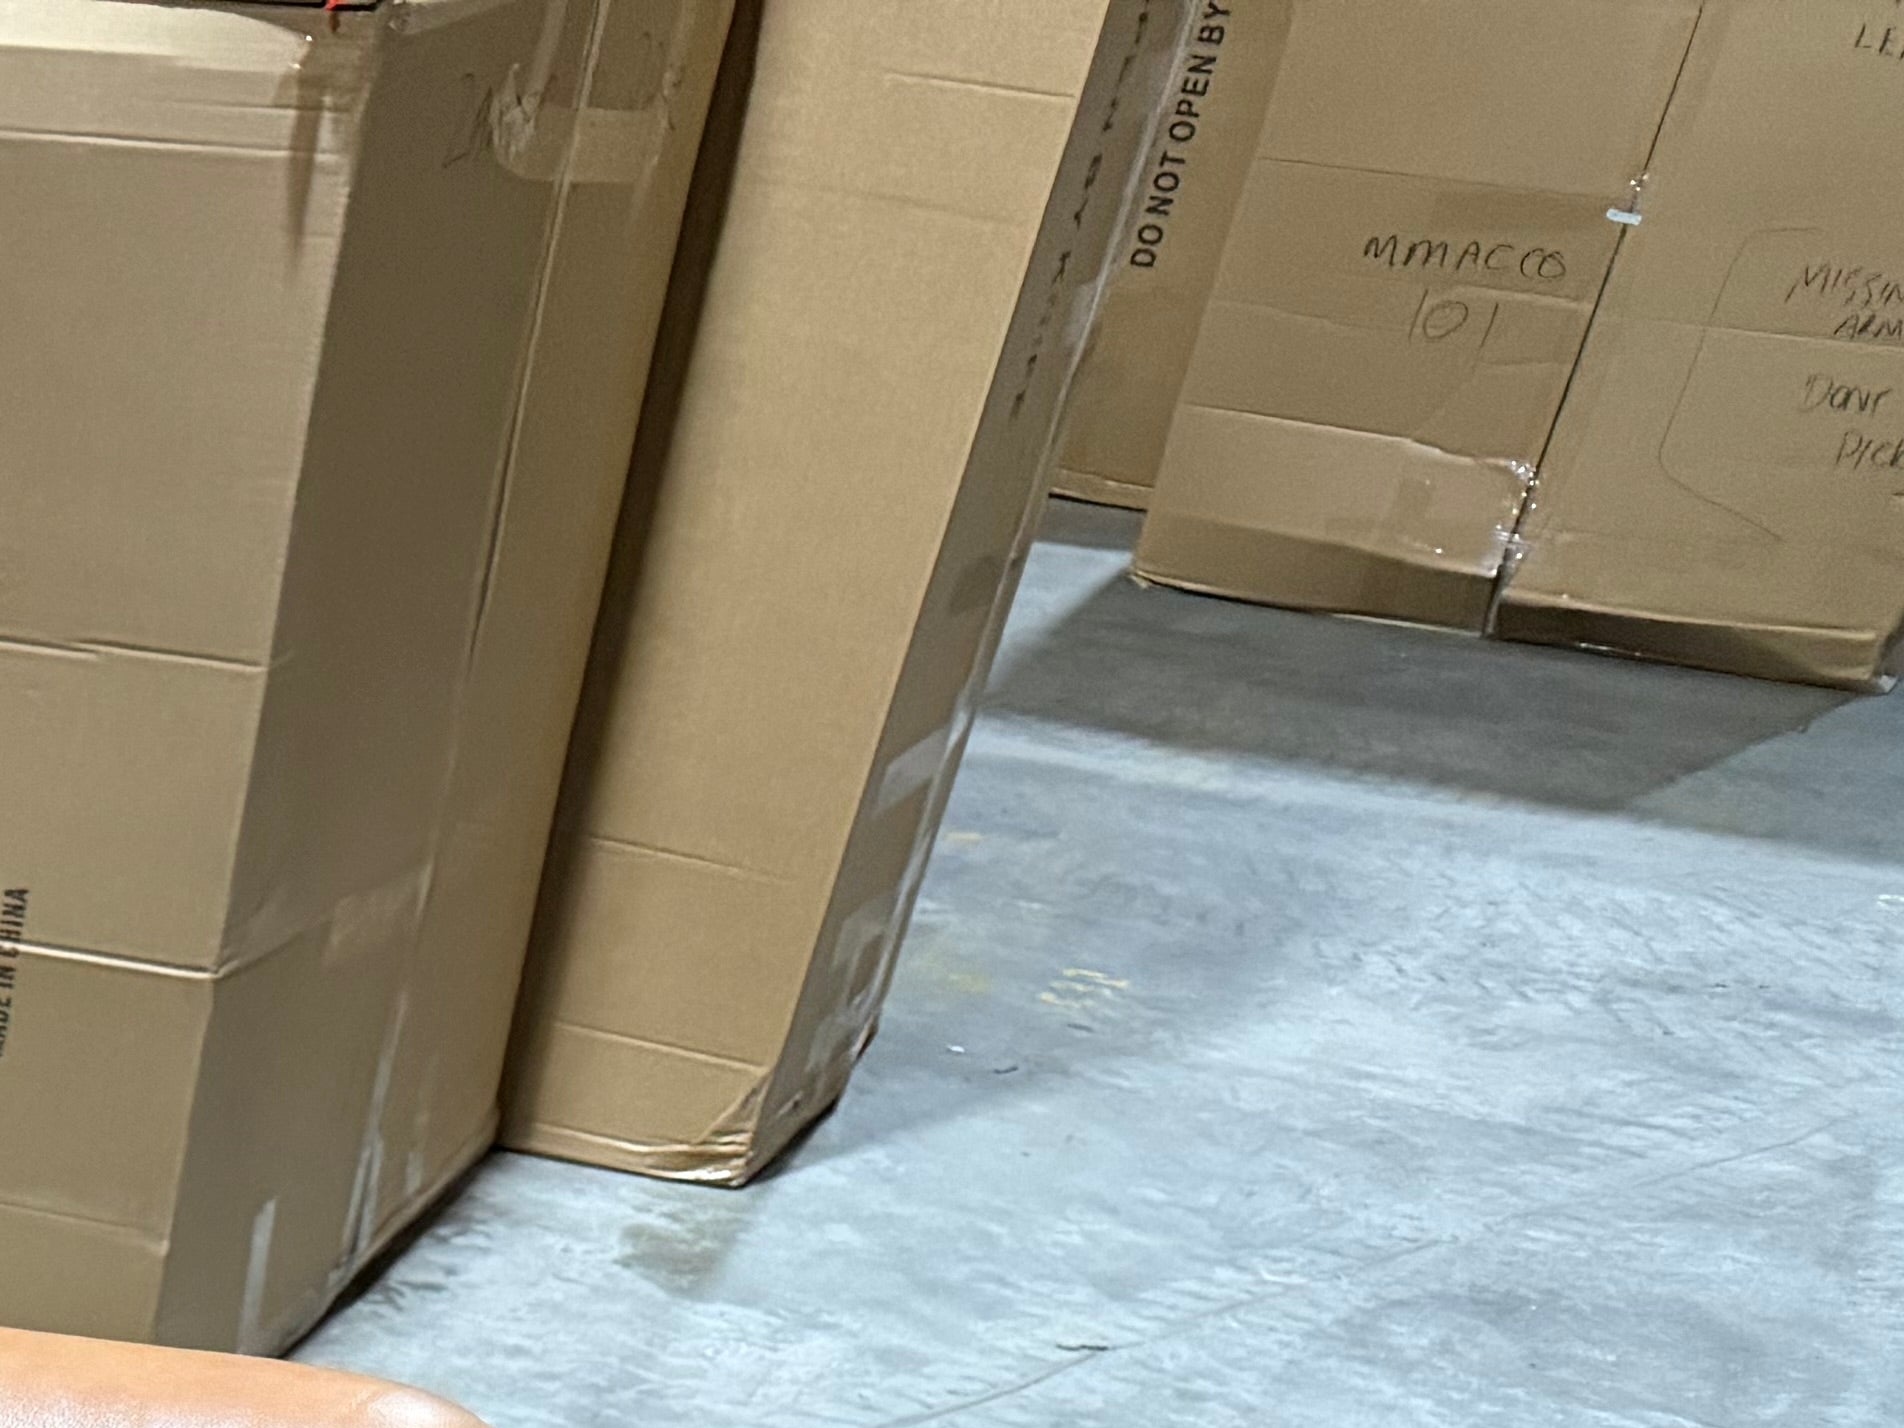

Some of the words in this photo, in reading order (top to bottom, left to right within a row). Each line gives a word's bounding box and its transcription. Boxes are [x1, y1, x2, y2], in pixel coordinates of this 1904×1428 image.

[1130, 223, 1163, 268] DO
[1150, 151, 1186, 220] NOT
[1169, 55, 1218, 144] OPEN
[1198, 1, 1232, 48] BY
